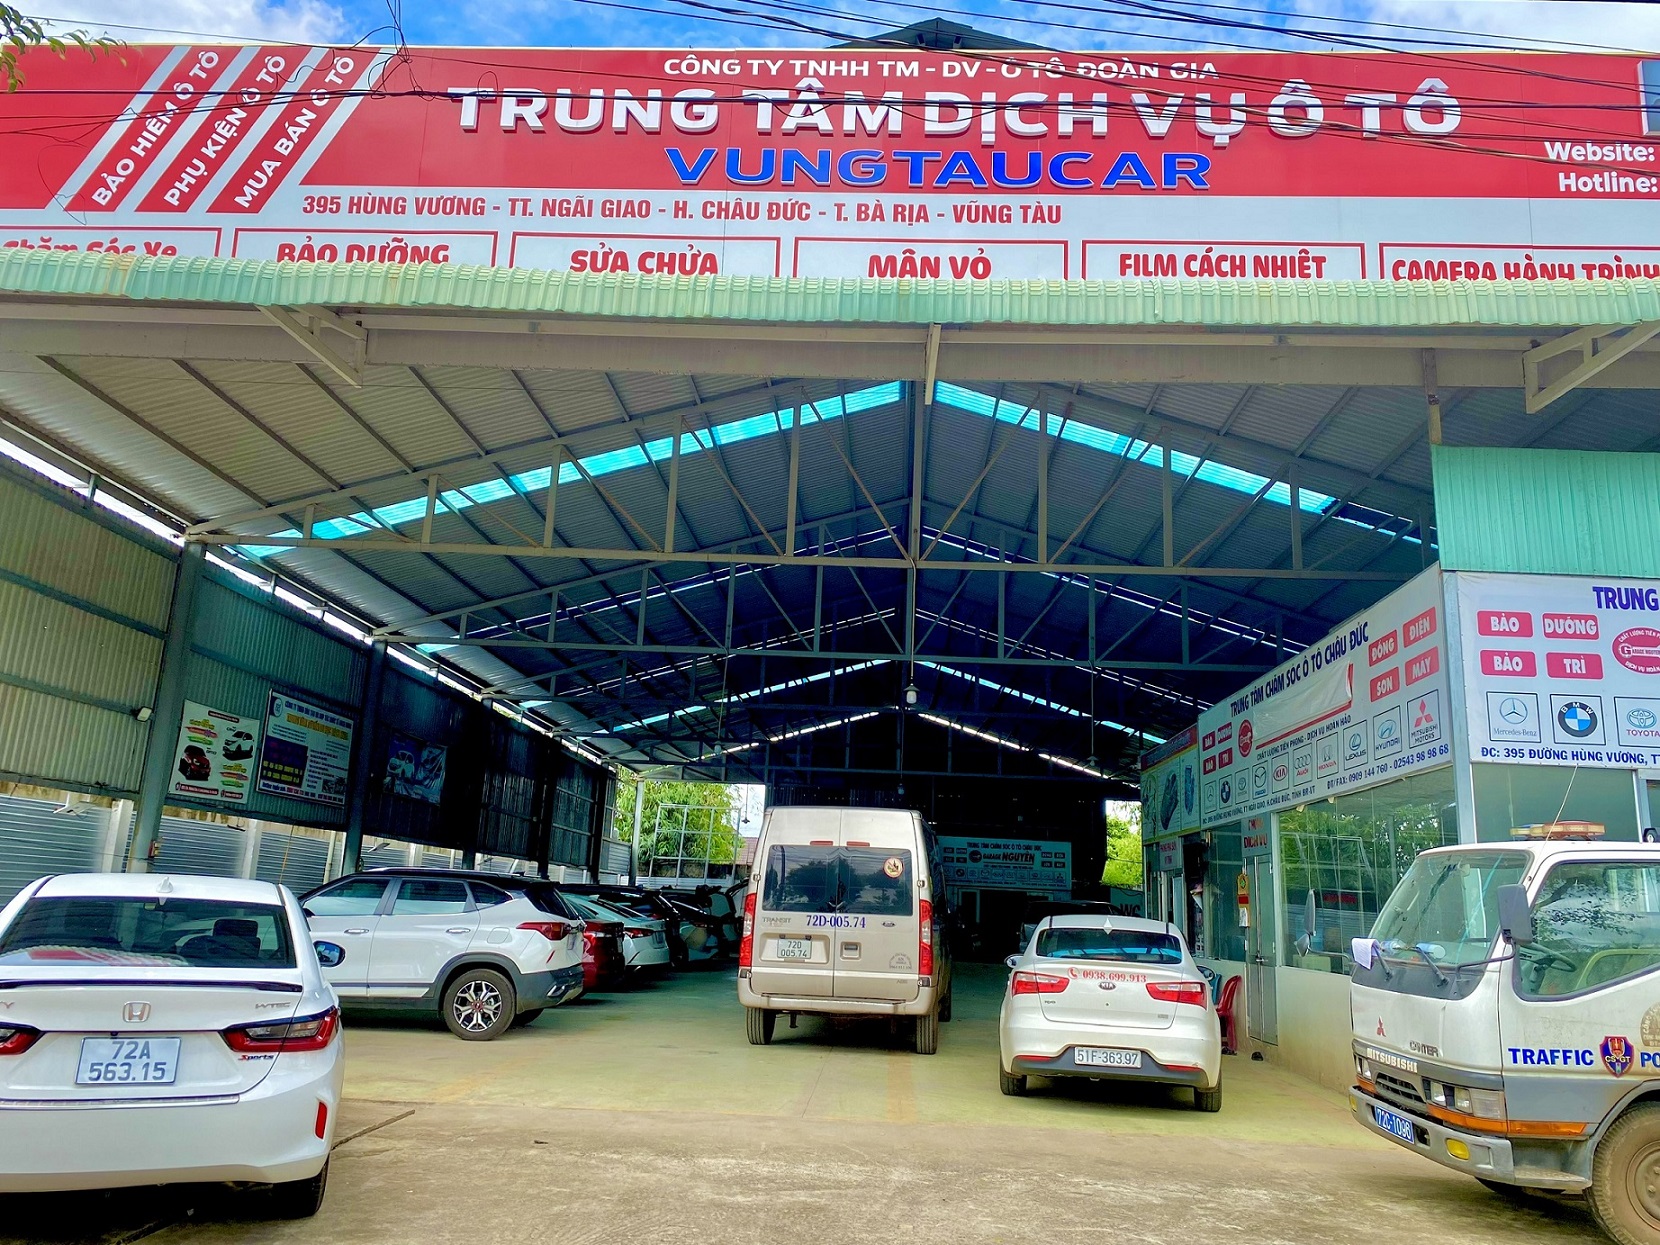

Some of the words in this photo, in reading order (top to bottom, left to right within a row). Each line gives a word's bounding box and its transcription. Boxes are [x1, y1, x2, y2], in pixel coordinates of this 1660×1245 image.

[664, 54, 741, 77] CÔNG
[753, 60, 784, 77] TY
[789, 60, 869, 78] TNHH
[877, 61, 919, 78] TM
[942, 61, 976, 78] DV
[1036, 57, 1064, 79] TÔ
[1170, 62, 1219, 79] GIA
[448, 86, 721, 134] TRUNG
[743, 78, 902, 137] TÂM
[924, 91, 1109, 147] DỊCH
[1131, 91, 1247, 147] VỤ
[1266, 78, 1324, 138] Ô
[1344, 77, 1462, 139] TÔ
[91, 157, 135, 206] BẢO
[173, 82, 194, 101] Ô
[189, 51, 219, 79] TÔ
[163, 159, 209, 206] PHỤ
[200, 107, 248, 159] KIỆN
[256, 55, 286, 84] TÔ
[234, 159, 282, 208] MUA
[273, 107, 317, 157] BÁN
[309, 87, 331, 107] Ô
[324, 55, 355, 85] TÔ
[1544, 140, 1655, 162] Website:
[663, 147, 1211, 190] VUNGTAUCAR
[1558, 172, 1658, 193] Hotline:
[302, 194, 343, 215] 395
[349, 190, 409, 216] HÙNG
[414, 196, 486, 218] VƯƠNG
[508, 199, 534, 217] TT.
[541, 197, 594, 219] NGÃI
[601, 200, 652, 219] GIAO
[673, 201, 693, 220] H.
[702, 197, 760, 221] CHÂU
[767, 197, 811, 222] ĐỨC
[834, 203, 849, 222] T.
[856, 199, 885, 223] BÀ
[889, 204, 929, 227] RỊA
[952, 200, 1012, 224] VŨNG
[1020, 202, 1062, 224] TÀU
[277, 235, 339, 263] BẢO
[345, 236, 449, 264] DƯỠNG
[569, 242, 630, 274] SỬA
[637, 243, 719, 276] CHỬA
[948, 247, 992, 280] VỎ
[1119, 253, 1178, 277] FILM
[1183, 246, 1247, 278] CÁCH
[1391, 259, 1498, 282] CAMERA
[1503, 253, 1575, 281] HÀNH
[1591, 586, 1659, 610] TRUNG
[1490, 613, 1520, 632] BẢO
[1311, 647, 1322, 673] TÔ
[1493, 652, 1523, 672] BẢO
[1561, 702, 1594, 714] BMW
[1493, 727, 1537, 737] Mercedes-Benz
[1393, 754, 1414, 769] 02543
[1416, 751, 1426, 762] 98
[1427, 747, 1437, 759] 98
[1438, 743, 1449, 755] 68
[1481, 747, 1500, 758] ĐC:
[1504, 748, 1525, 759] 395
[1571, 748, 1603, 762] HÙNG
[1275, 767, 1286, 777] KIA
[806, 914, 867, 929] 72D-005.74
[780, 949, 807, 957] 005.74
[1082, 970, 1147, 983] 0938.699.913
[111, 1041, 151, 1060] 72A
[1077, 1049, 1138, 1066] 51F-363.97
[1366, 1047, 1418, 1073] MITSUBISHI
[1508, 1047, 1595, 1066] TRAFFIC
[88, 1062, 167, 1083] 563.15
[1377, 1109, 1412, 1140] 72C-1096
